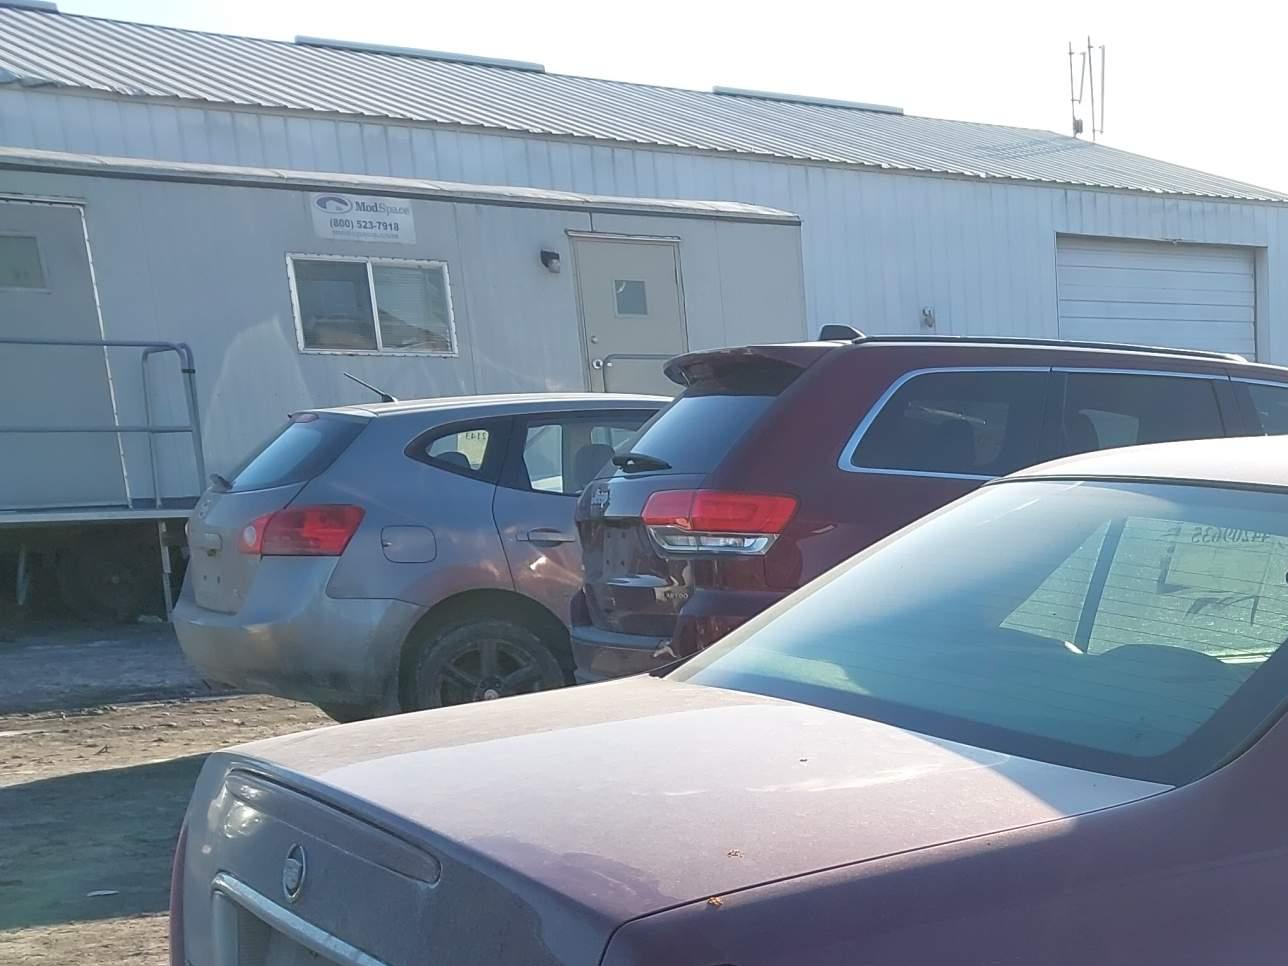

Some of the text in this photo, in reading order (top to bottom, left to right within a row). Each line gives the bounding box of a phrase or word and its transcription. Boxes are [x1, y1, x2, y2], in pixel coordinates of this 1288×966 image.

[355, 201, 410, 216] ModSpace
[329, 218, 399, 231] (800) 523-7918
